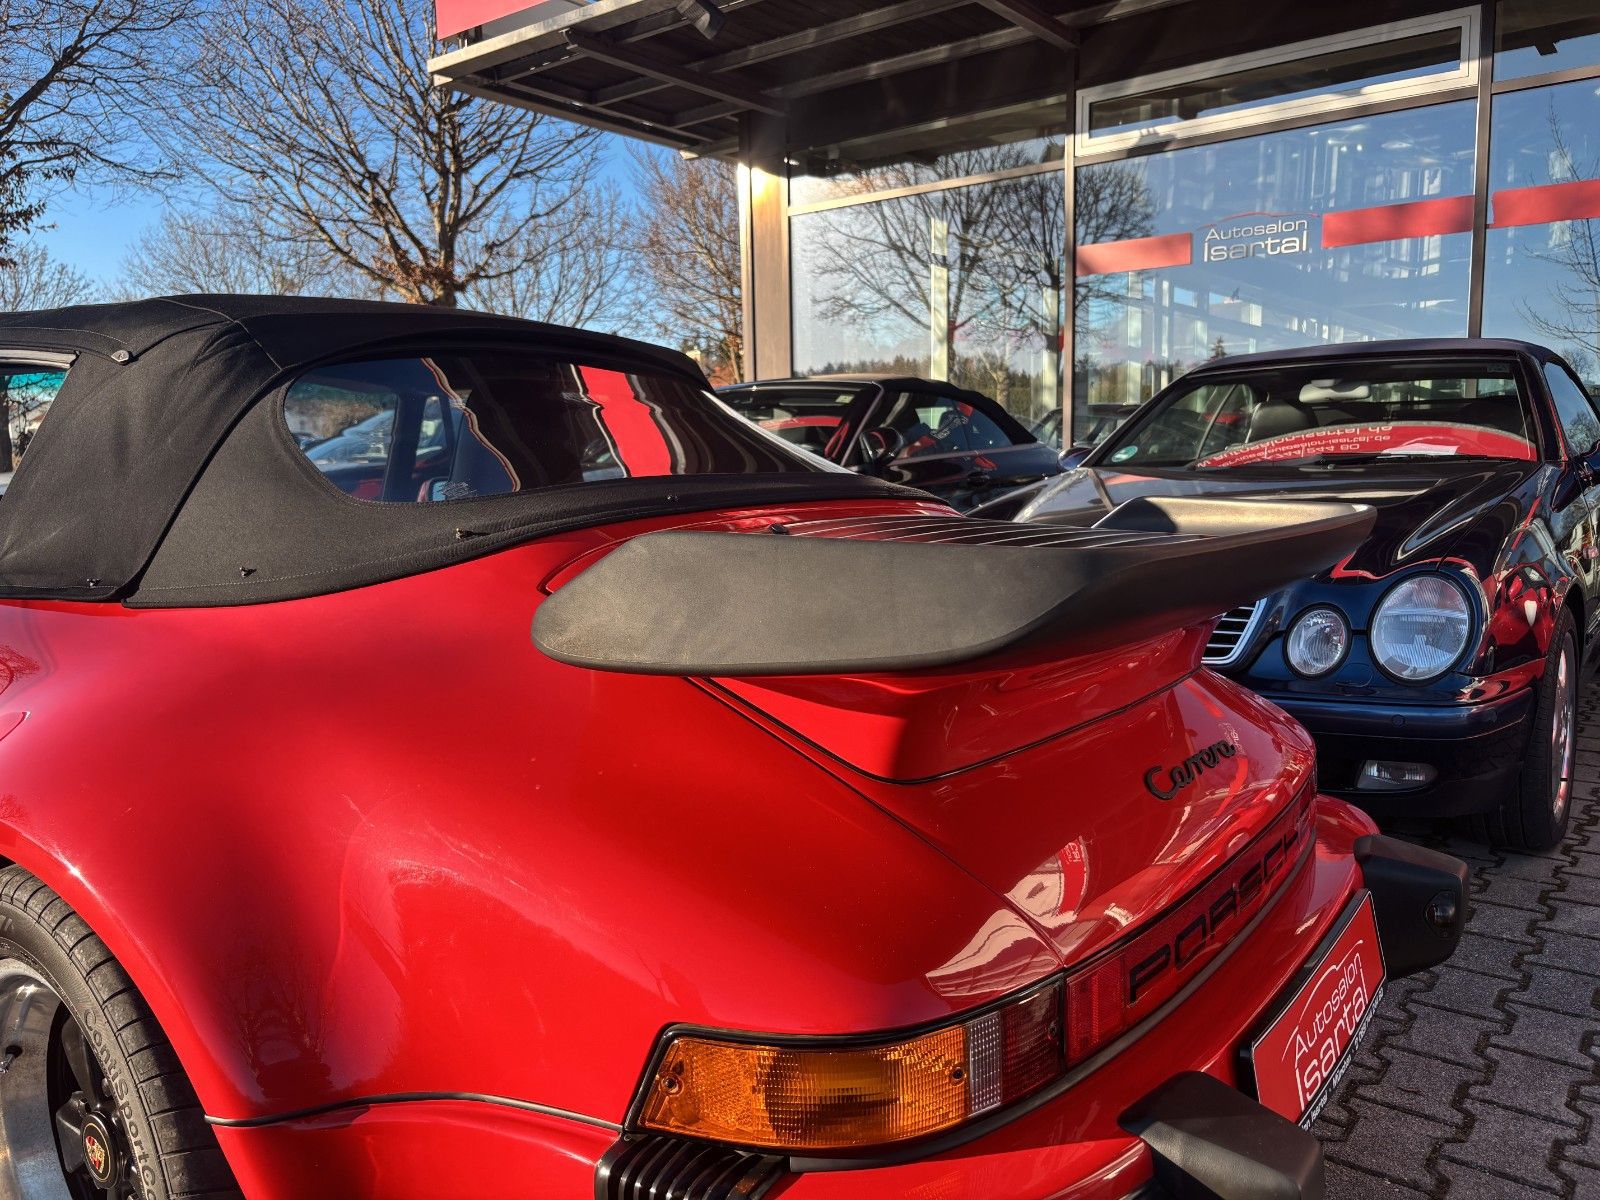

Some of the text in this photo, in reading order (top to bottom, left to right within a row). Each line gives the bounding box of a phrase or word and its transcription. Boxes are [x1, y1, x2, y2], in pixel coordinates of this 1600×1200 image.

[1203, 230, 1308, 263] Isartal
[1205, 219, 1308, 242] Autosalon
[1143, 739, 1237, 801] Carrera
[1294, 953, 1362, 1069] Autosalon
[1295, 968, 1369, 1112] Isartal
